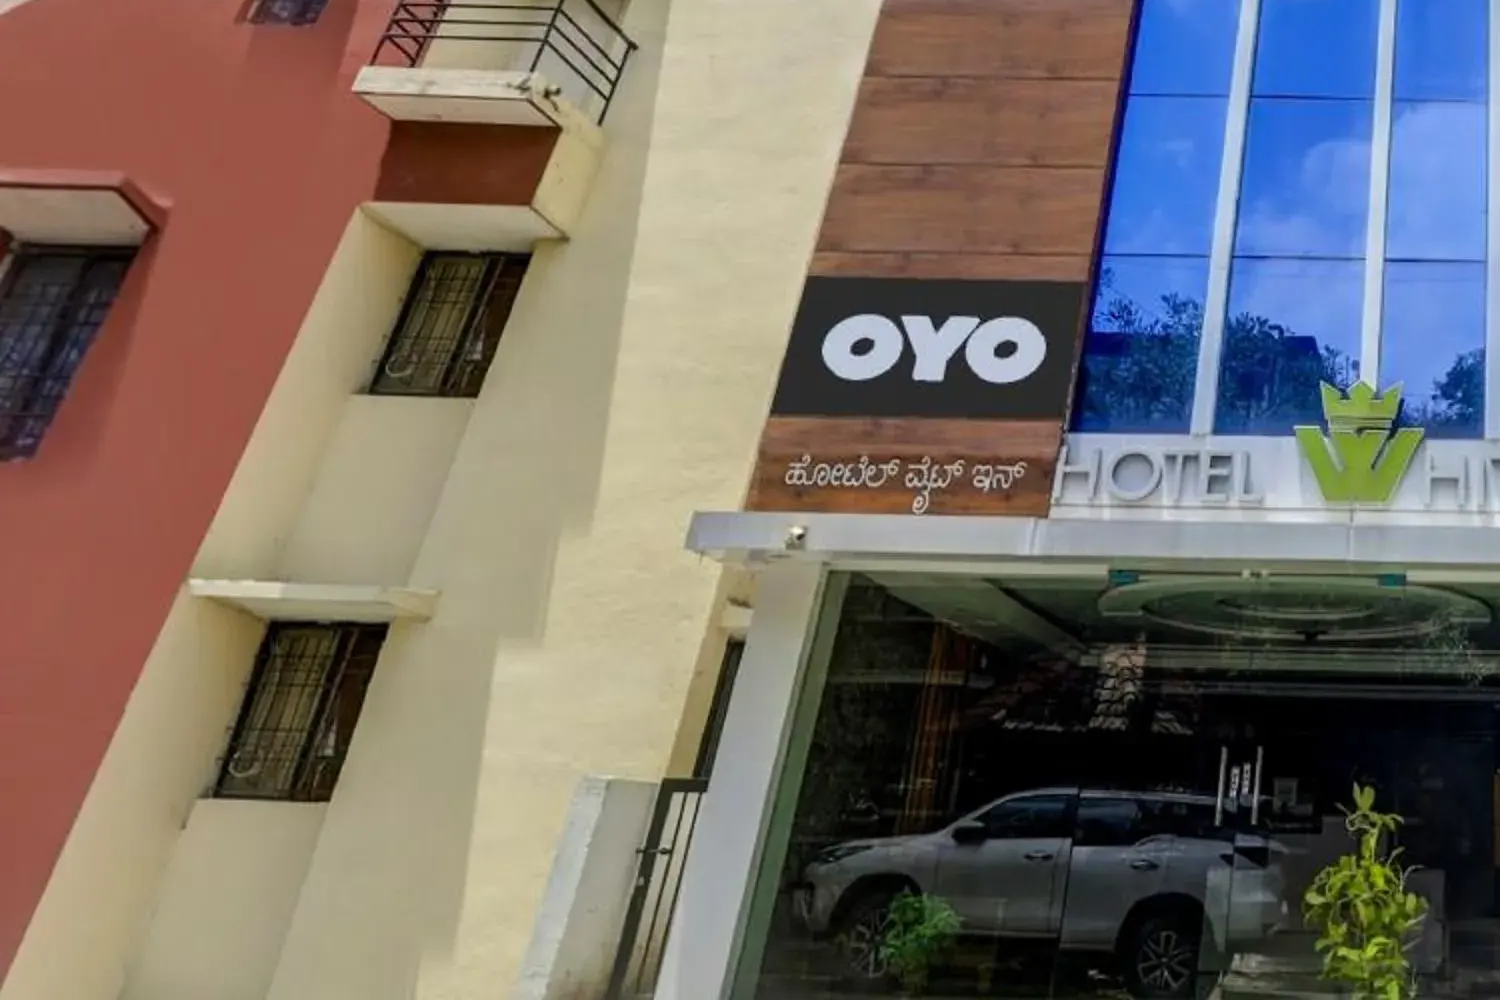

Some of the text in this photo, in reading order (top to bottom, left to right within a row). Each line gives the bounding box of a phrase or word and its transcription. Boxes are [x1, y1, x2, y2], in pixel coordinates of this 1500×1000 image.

[822, 314, 1047, 383] OYO
[785, 455, 900, 488] ಹೋಟೆಲ್
[972, 462, 1027, 492] ಇನ್
[1052, 449, 1264, 506] HOTEL
